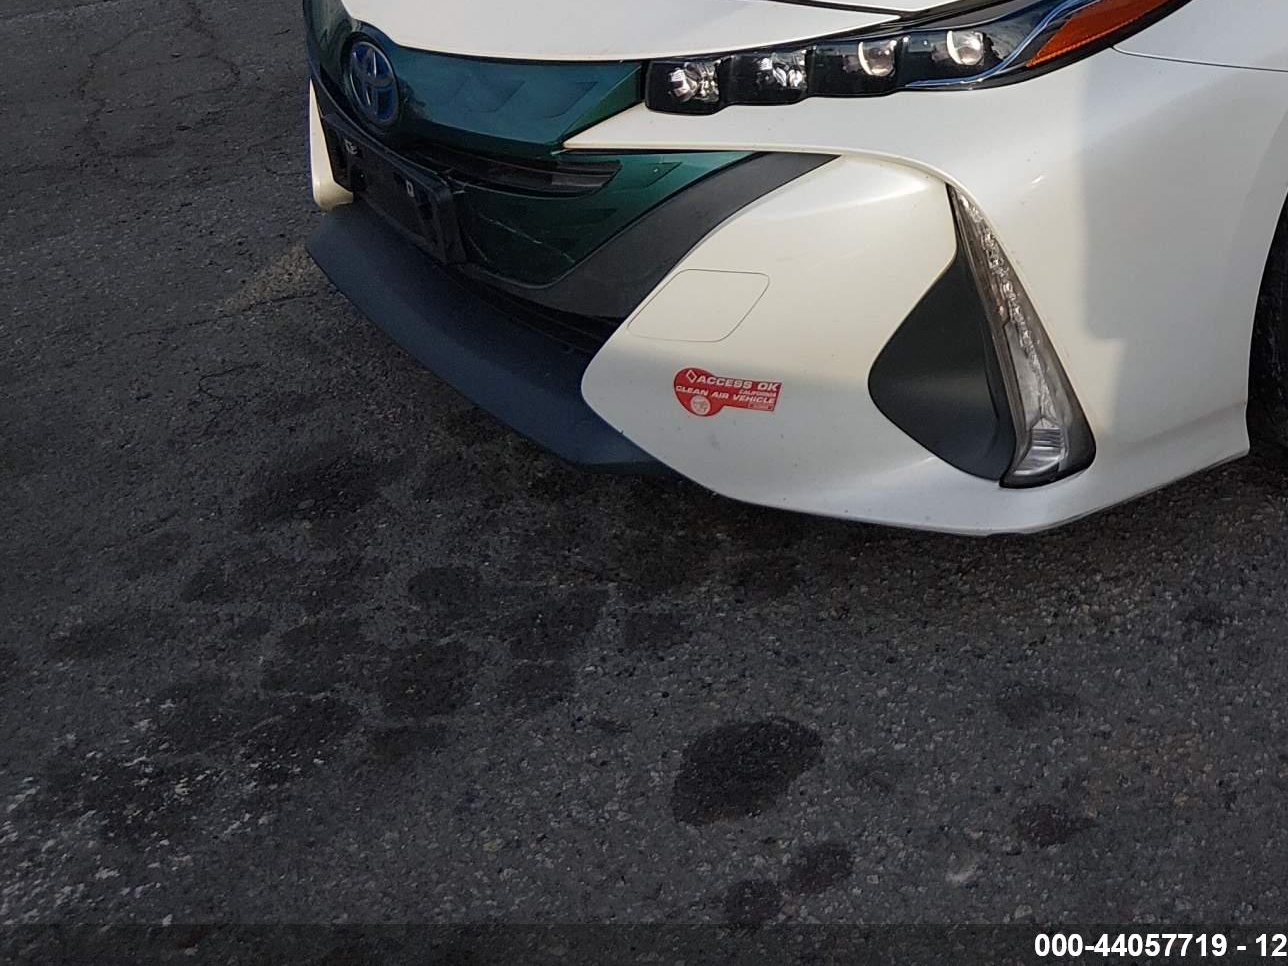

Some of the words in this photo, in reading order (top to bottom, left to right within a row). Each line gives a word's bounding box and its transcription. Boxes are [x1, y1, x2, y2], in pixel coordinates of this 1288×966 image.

[696, 375, 753, 389] ACCESS
[757, 382, 779, 391] OK
[675, 385, 709, 396] CLEAN
[711, 391, 730, 400] AIR
[733, 394, 776, 403] VEHICLE
